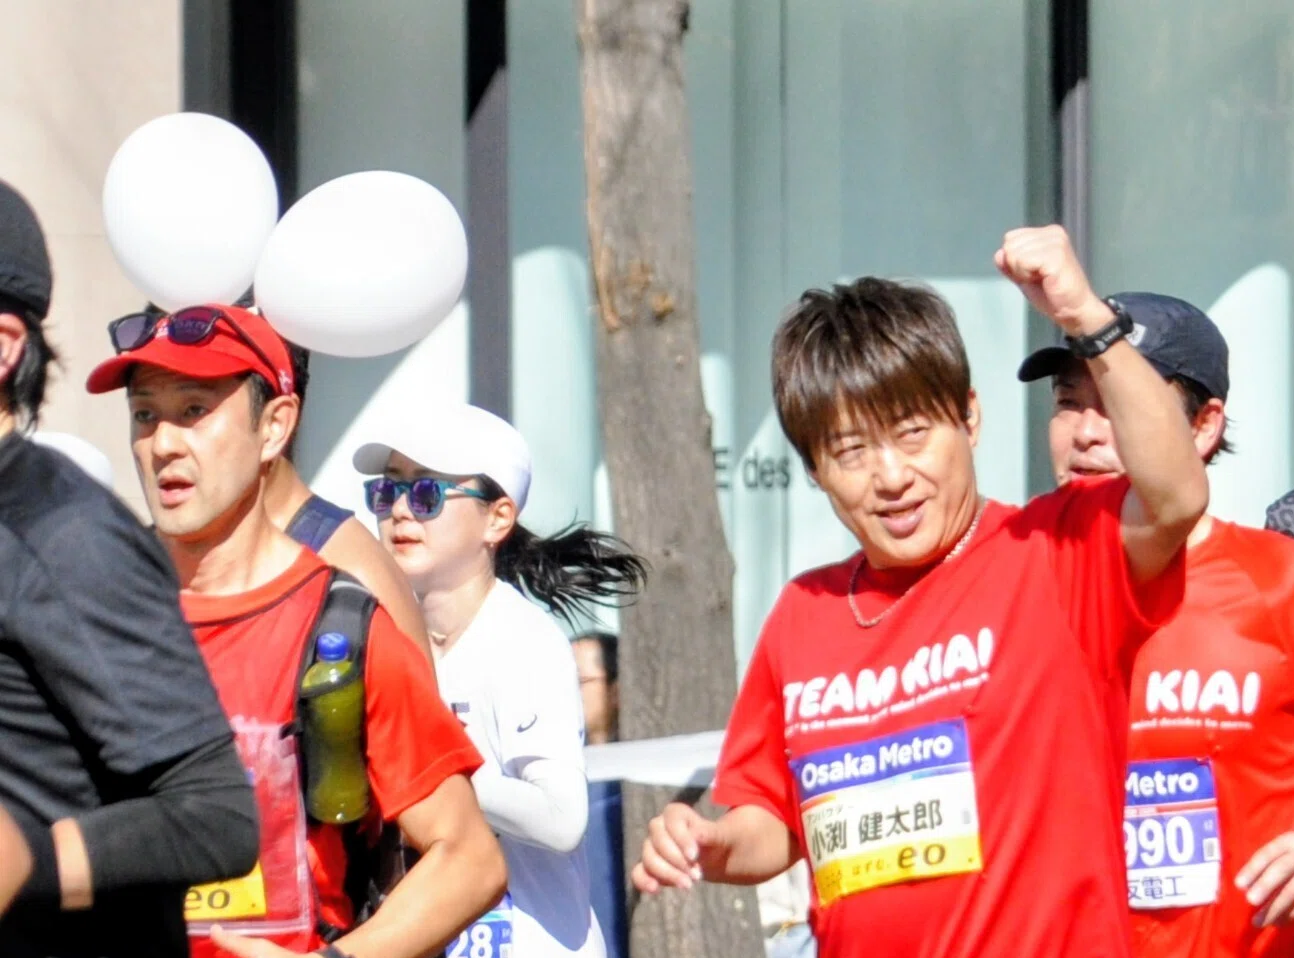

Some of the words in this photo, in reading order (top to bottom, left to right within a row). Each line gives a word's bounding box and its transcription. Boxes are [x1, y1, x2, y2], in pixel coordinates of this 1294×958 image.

[742, 449, 791, 489] des
[784, 666, 897, 722] TEAM
[901, 627, 993, 694] KIAI
[1146, 669, 1261, 715] KIAI
[802, 752, 876, 791] Osaka
[879, 735, 953, 771] Metro
[858, 799, 944, 844] 健太郎
[897, 843, 947, 869] eo
